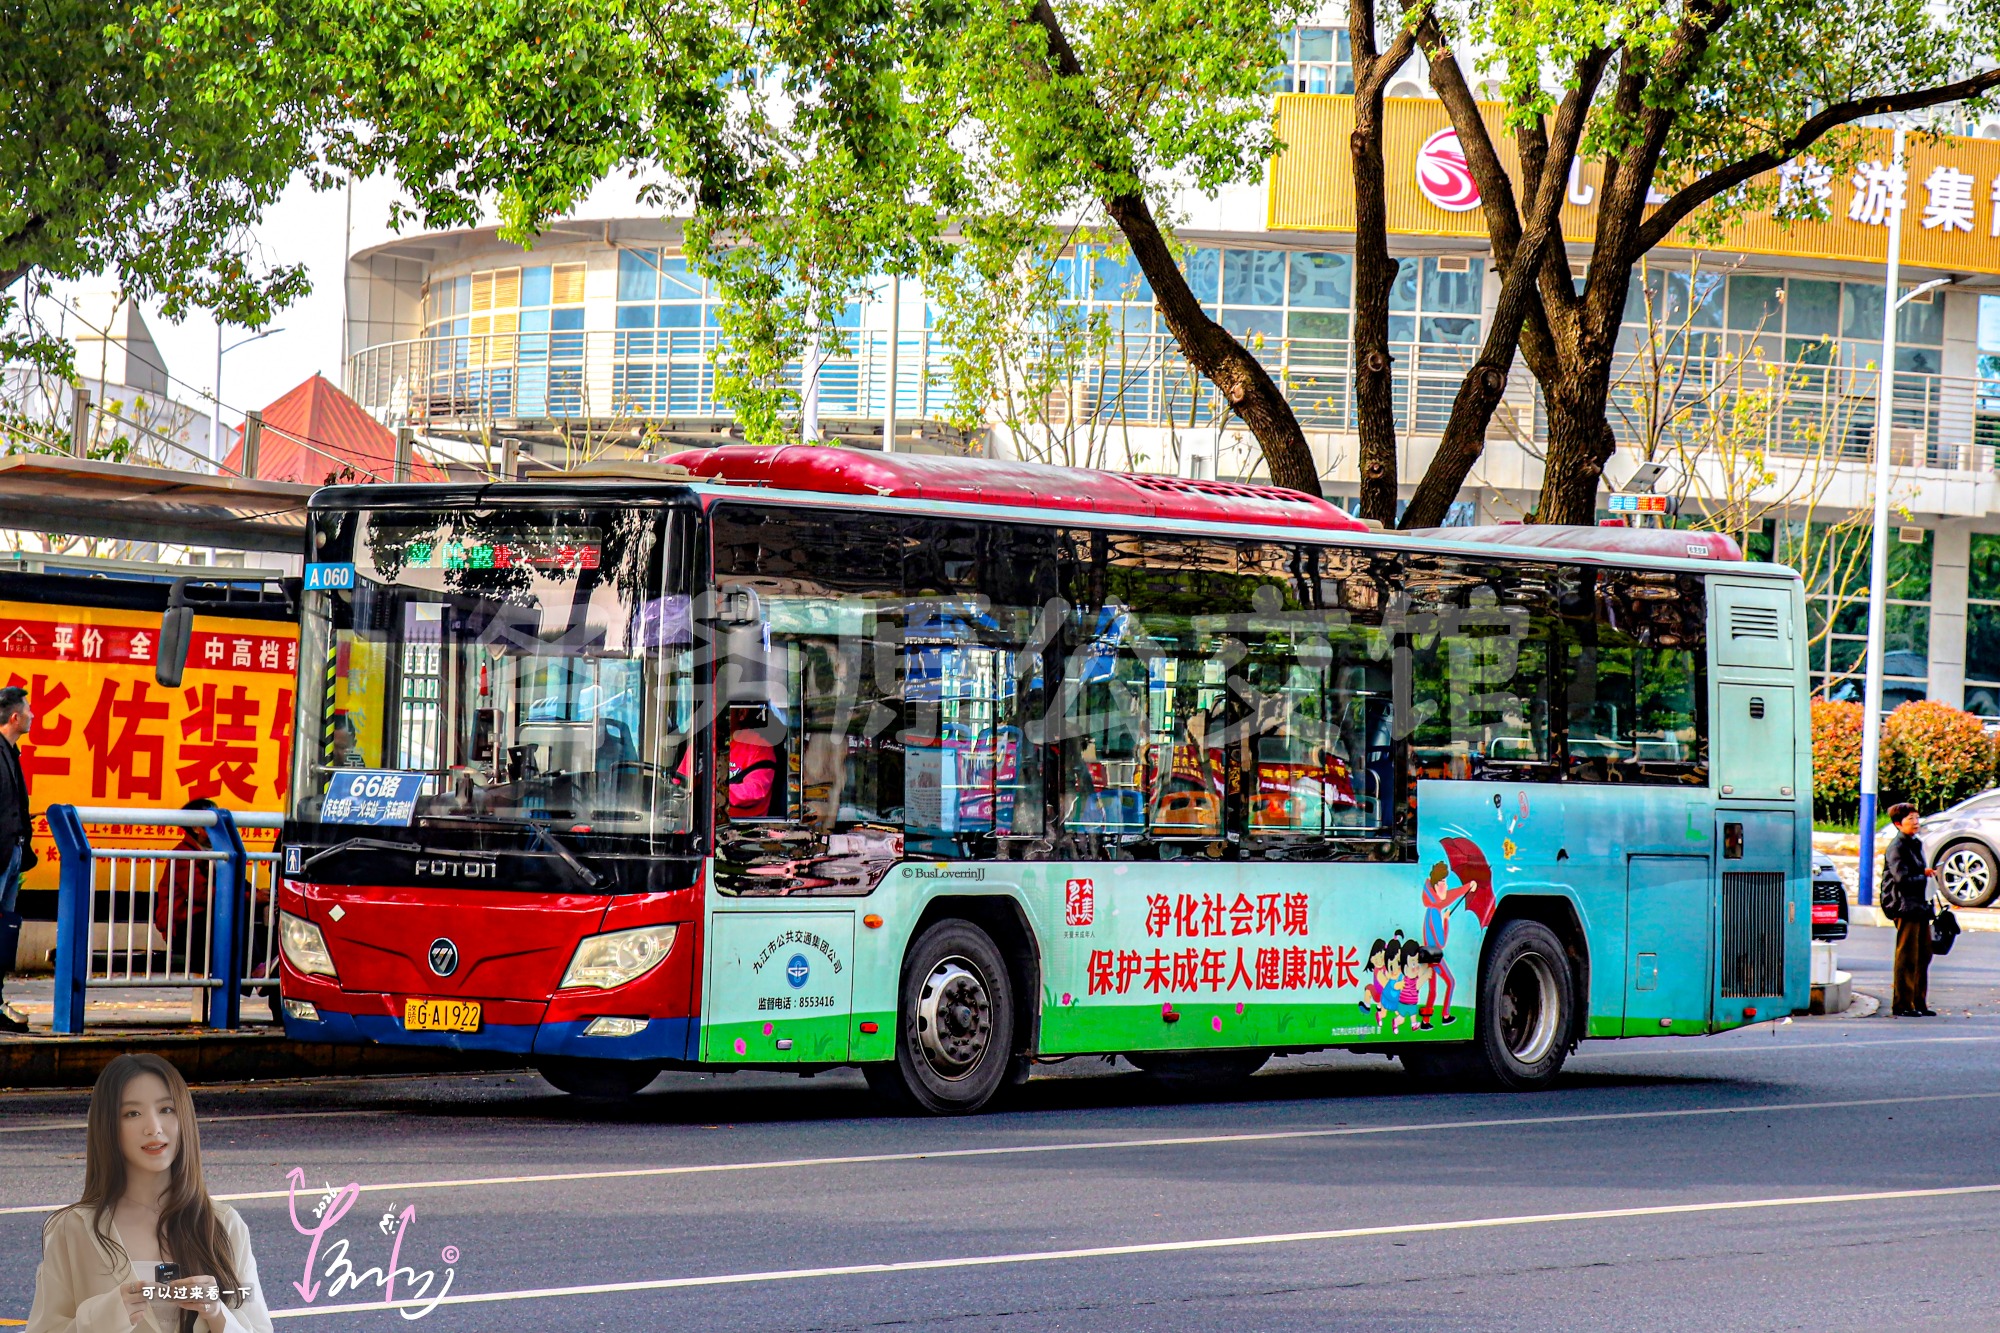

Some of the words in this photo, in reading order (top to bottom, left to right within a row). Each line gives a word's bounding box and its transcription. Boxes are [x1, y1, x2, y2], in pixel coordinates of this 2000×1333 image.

[309, 567, 320, 587] A
[323, 567, 349, 586] 060
[52, 626, 104, 659] 平价
[350, 775, 402, 798] 66路
[415, 859, 497, 878] FOTON
[1145, 891, 1309, 938] 净化社会环境
[753, 929, 843, 975] 九江市公共交通集团公司
[1086, 944, 1361, 996] 保护未成年人健康成长
